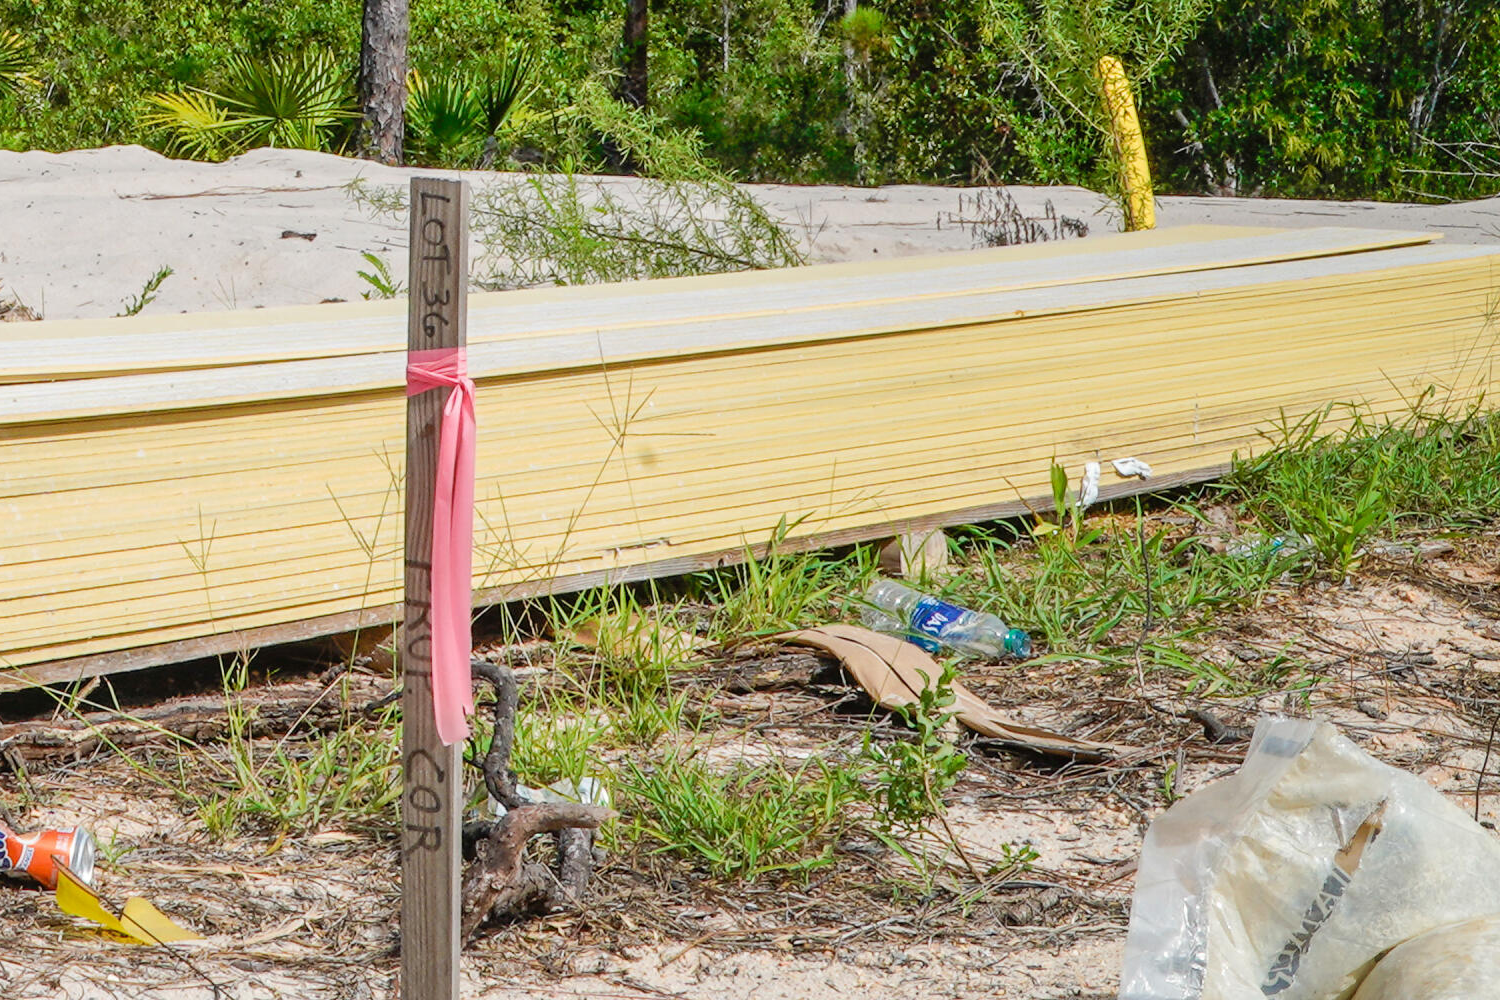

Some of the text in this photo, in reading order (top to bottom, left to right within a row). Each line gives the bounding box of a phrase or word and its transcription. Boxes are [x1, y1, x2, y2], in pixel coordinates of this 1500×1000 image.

[420, 192, 450, 338] LOT 36
[405, 748, 445, 860] COR
